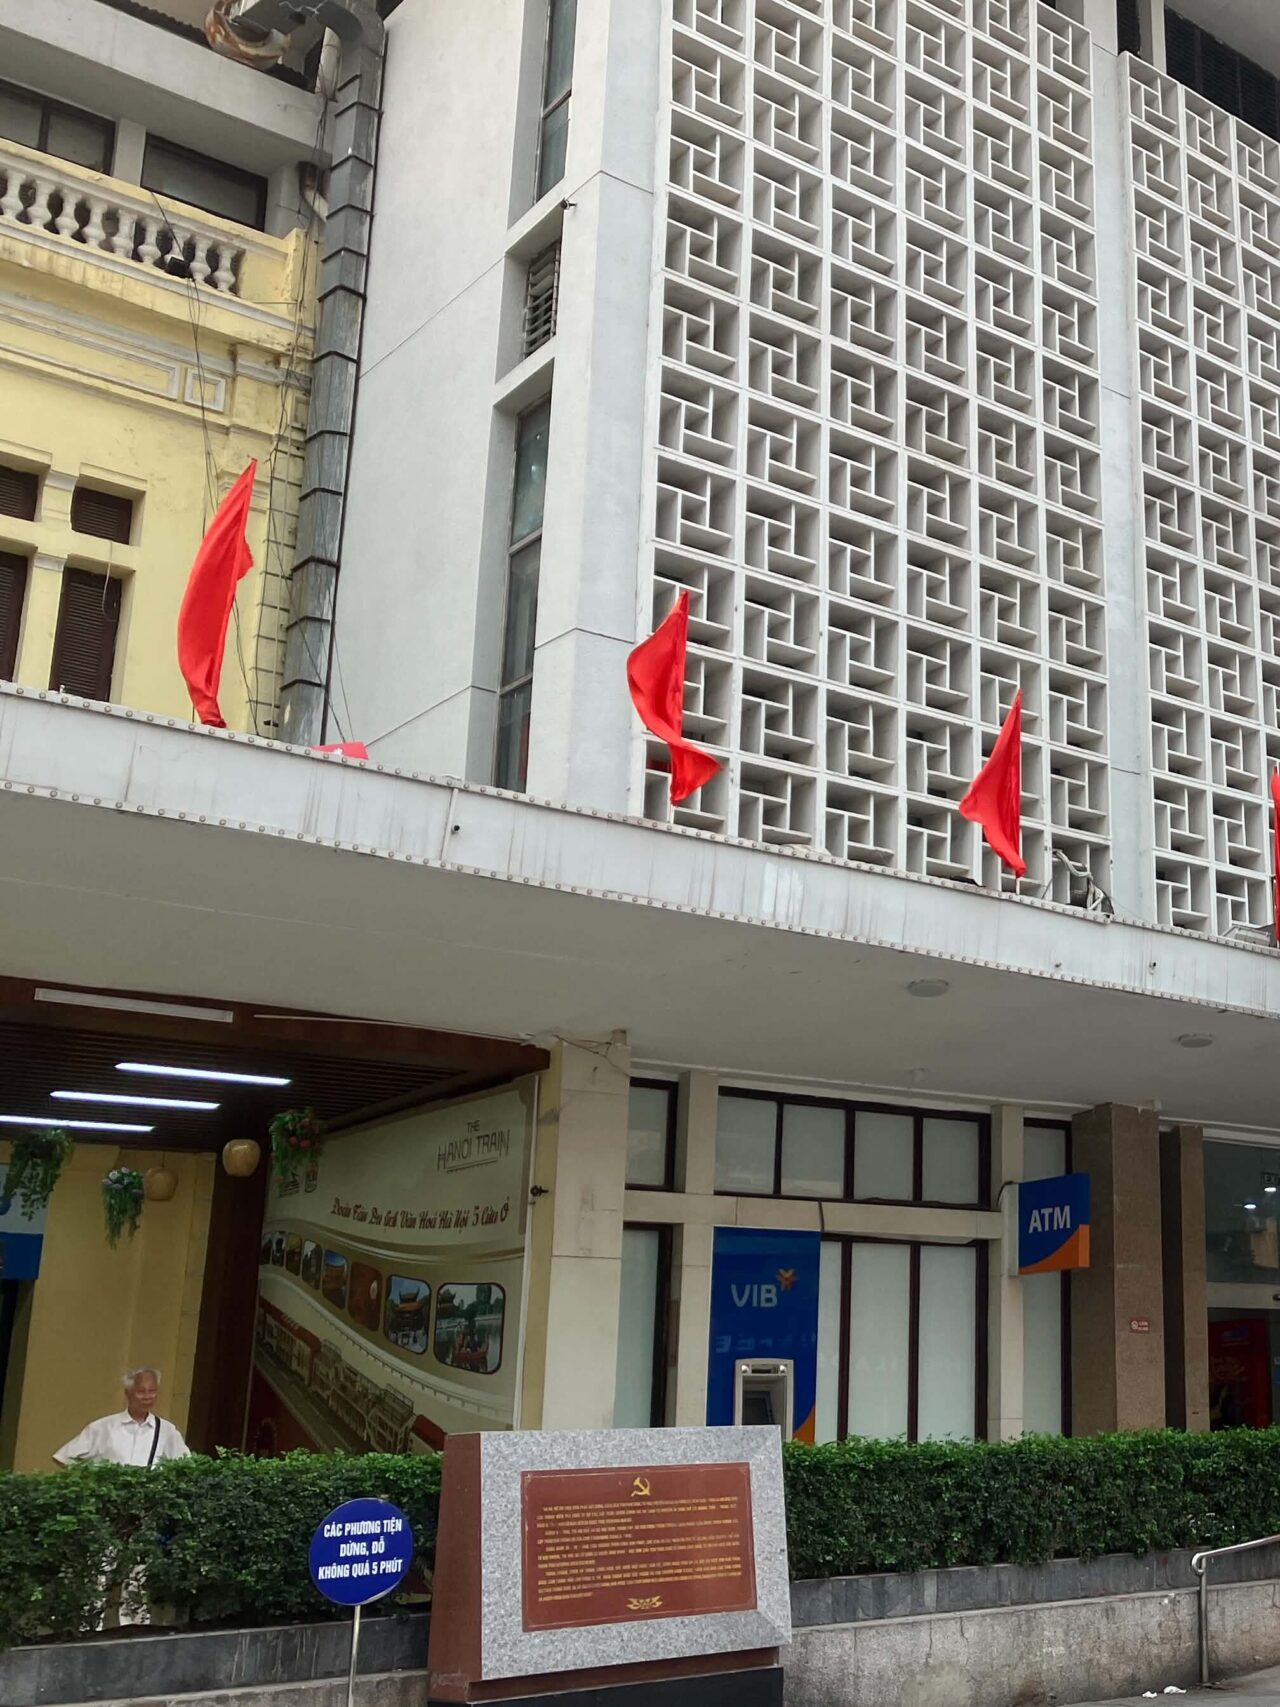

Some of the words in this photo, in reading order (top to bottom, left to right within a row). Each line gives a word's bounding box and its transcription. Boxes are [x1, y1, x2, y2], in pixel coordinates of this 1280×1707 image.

[467, 1119, 481, 1133] THE
[436, 1137, 473, 1171] HANOI
[476, 1129, 511, 1157] TRAIN
[1028, 1204, 1071, 1234] ATM
[731, 1284, 778, 1308] VIB
[324, 1521, 343, 1537] CÁC
[344, 1519, 381, 1536] PHƯƠNG
[383, 1516, 403, 1535] TIỆN
[318, 1562, 350, 1580] KHÔNG
[351, 1559, 370, 1578] QUÁ
[372, 1561, 378, 1575] 5
[380, 1557, 403, 1574] PHÚT
